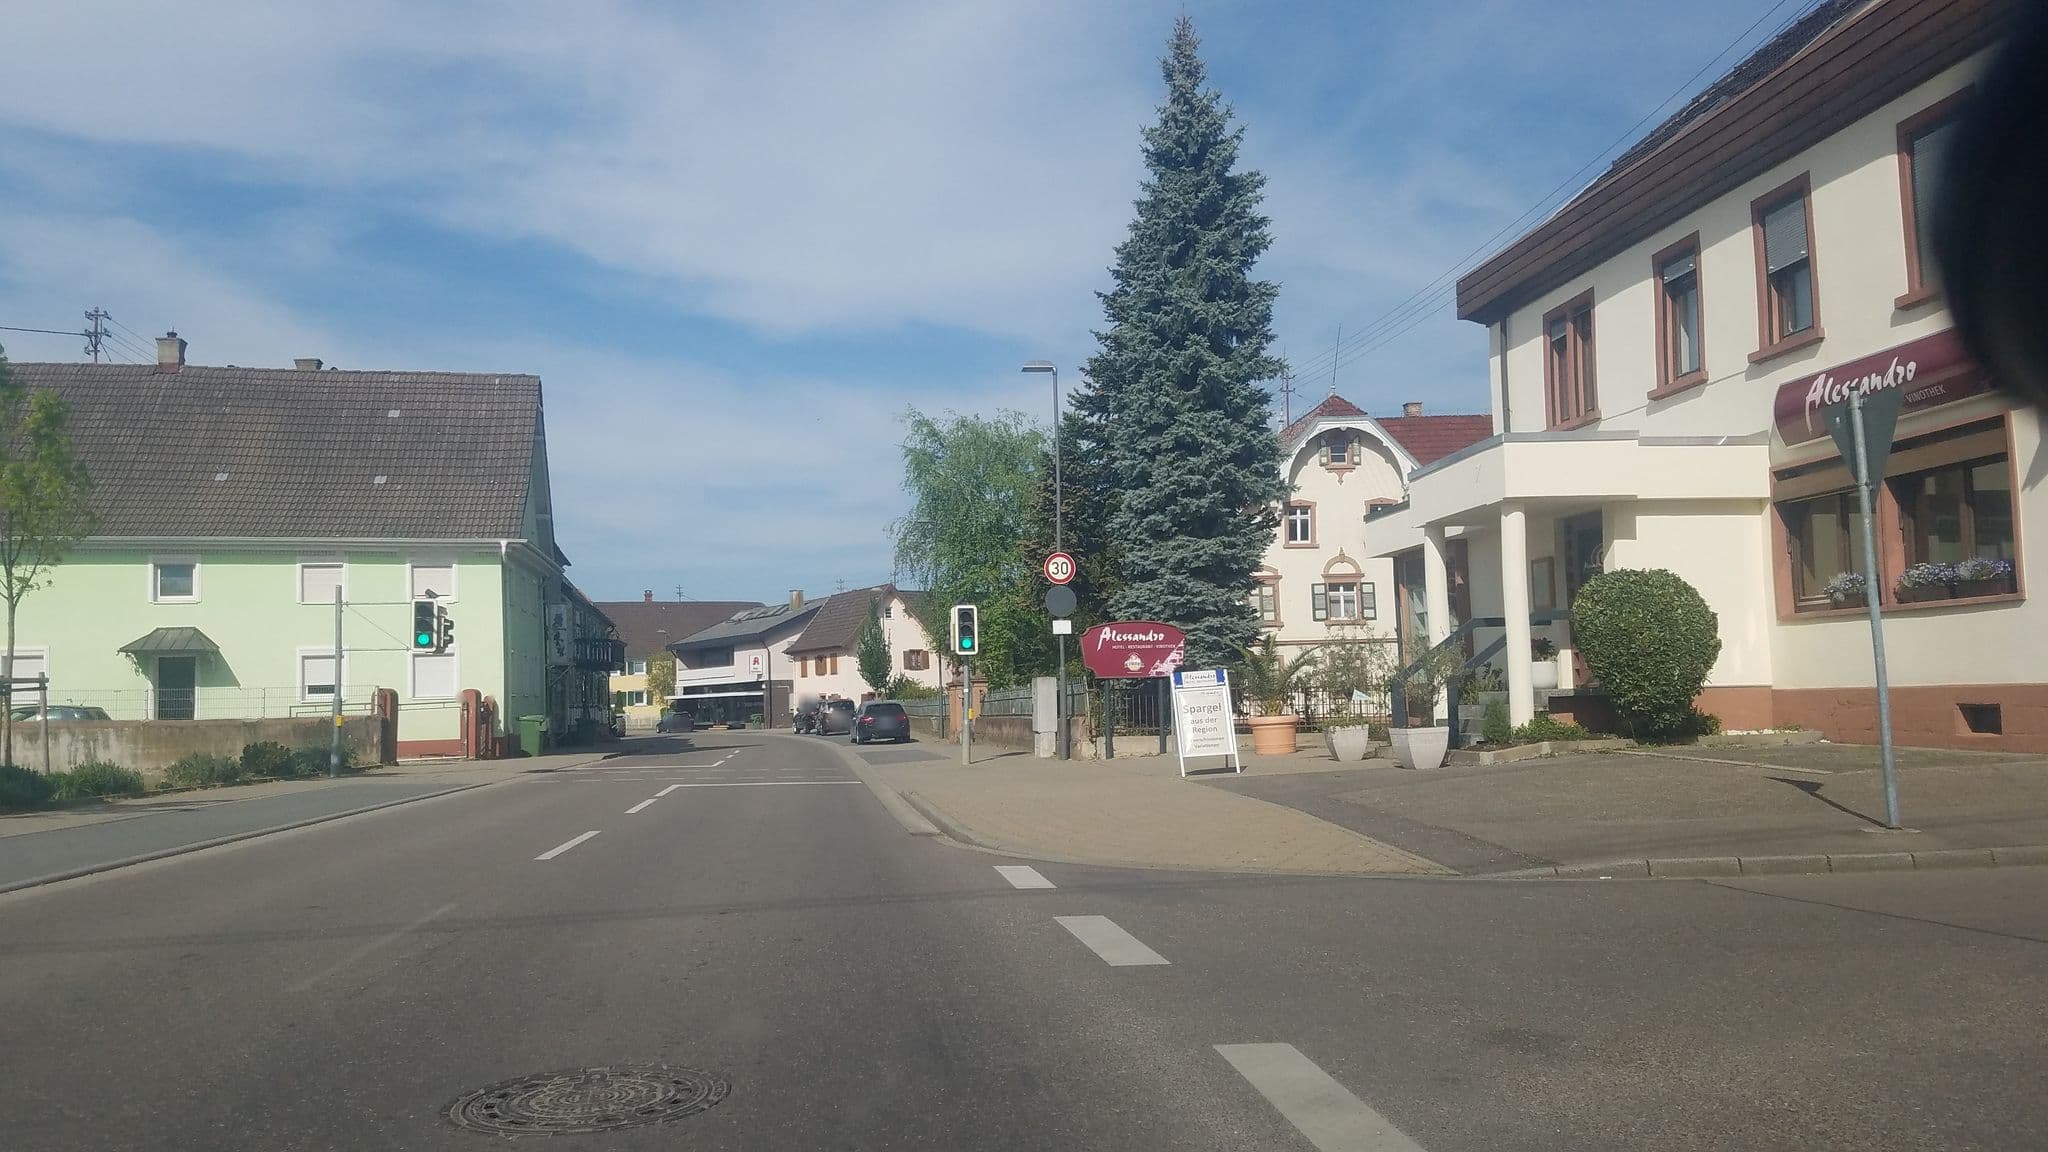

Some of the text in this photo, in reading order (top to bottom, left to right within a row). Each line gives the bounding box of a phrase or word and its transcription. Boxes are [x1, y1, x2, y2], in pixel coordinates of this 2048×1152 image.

[1905, 384, 1946, 404] VINOTHEK
[1051, 561, 1069, 575] 30
[1097, 626, 1165, 652] Alessandro
[1183, 702, 1222, 716] Spargel
[1190, 715, 1217, 725] aus der
[1192, 725, 1218, 735] Region
